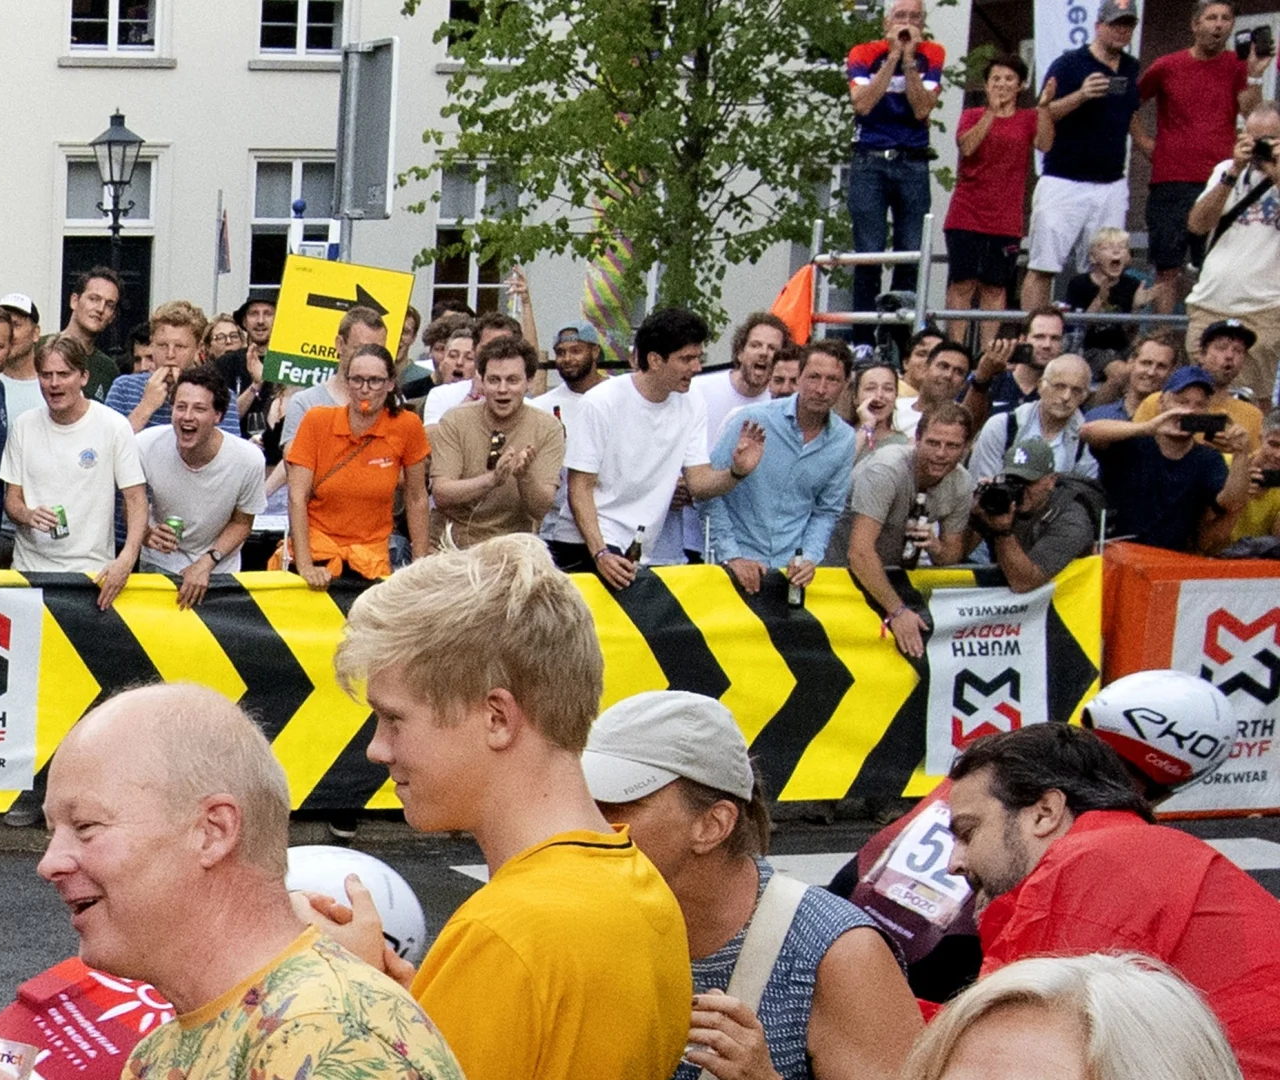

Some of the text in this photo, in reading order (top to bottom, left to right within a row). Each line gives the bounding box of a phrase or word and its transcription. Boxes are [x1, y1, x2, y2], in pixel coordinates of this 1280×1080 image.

[952, 623, 1022, 640] MODYF
[1237, 719, 1276, 738] RTH
[1228, 740, 1272, 759] DYF
[1202, 770, 1267, 785] ORKWEAR
